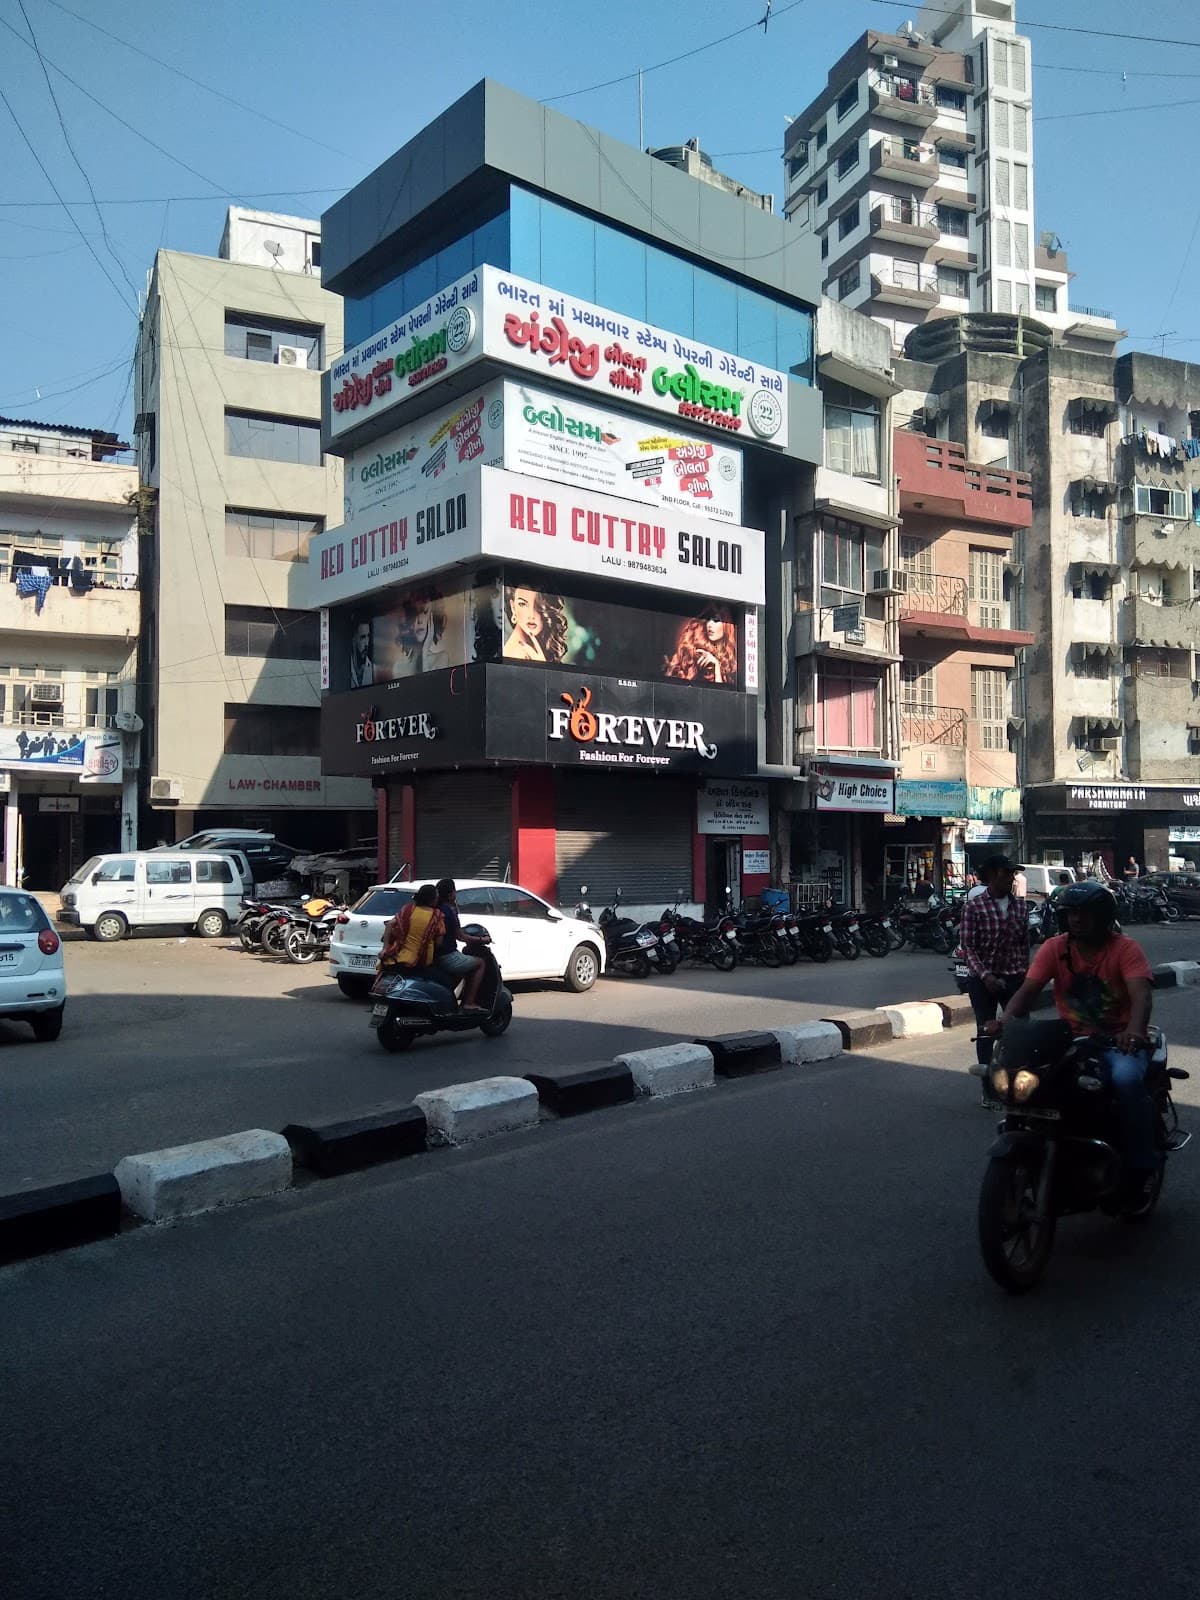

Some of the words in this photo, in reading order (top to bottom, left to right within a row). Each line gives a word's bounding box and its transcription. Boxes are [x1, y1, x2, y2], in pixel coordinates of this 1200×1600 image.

[497, 281, 541, 308] ભારત
[548, 298, 565, 317] માં
[571, 307, 629, 340] પ્રથમવાર
[673, 338, 713, 369] પેપરની
[760, 374, 783, 393] સાથે
[504, 311, 600, 379] અંગ્રેજી
[651, 363, 742, 417] બ્લોસમ
[523, 405, 602, 443] બ્લોસમ
[758, 404, 774, 421] 22
[548, 444, 571, 455] SINCE
[675, 441, 707, 459] અંગ્રેજી
[673, 460, 706, 476] બોલતા
[320, 542, 344, 580] RED
[351, 517, 408, 569] CUTTRY
[416, 493, 467, 545] SALON
[509, 493, 557, 537] RED
[571, 507, 666, 559] CUTTRY
[678, 531, 743, 575] SALON
[601, 555, 621, 565] LALU
[355, 705, 438, 744] FOREVER
[549, 688, 718, 759] FOREVER
[371, 753, 390, 765] Fashion
[399, 751, 420, 761] Forever
[579, 750, 617, 763] Fashion
[618, 752, 634, 763] For
[635, 753, 670, 764] Forever
[838, 782, 857, 799] High
[860, 783, 887, 798] Choice
